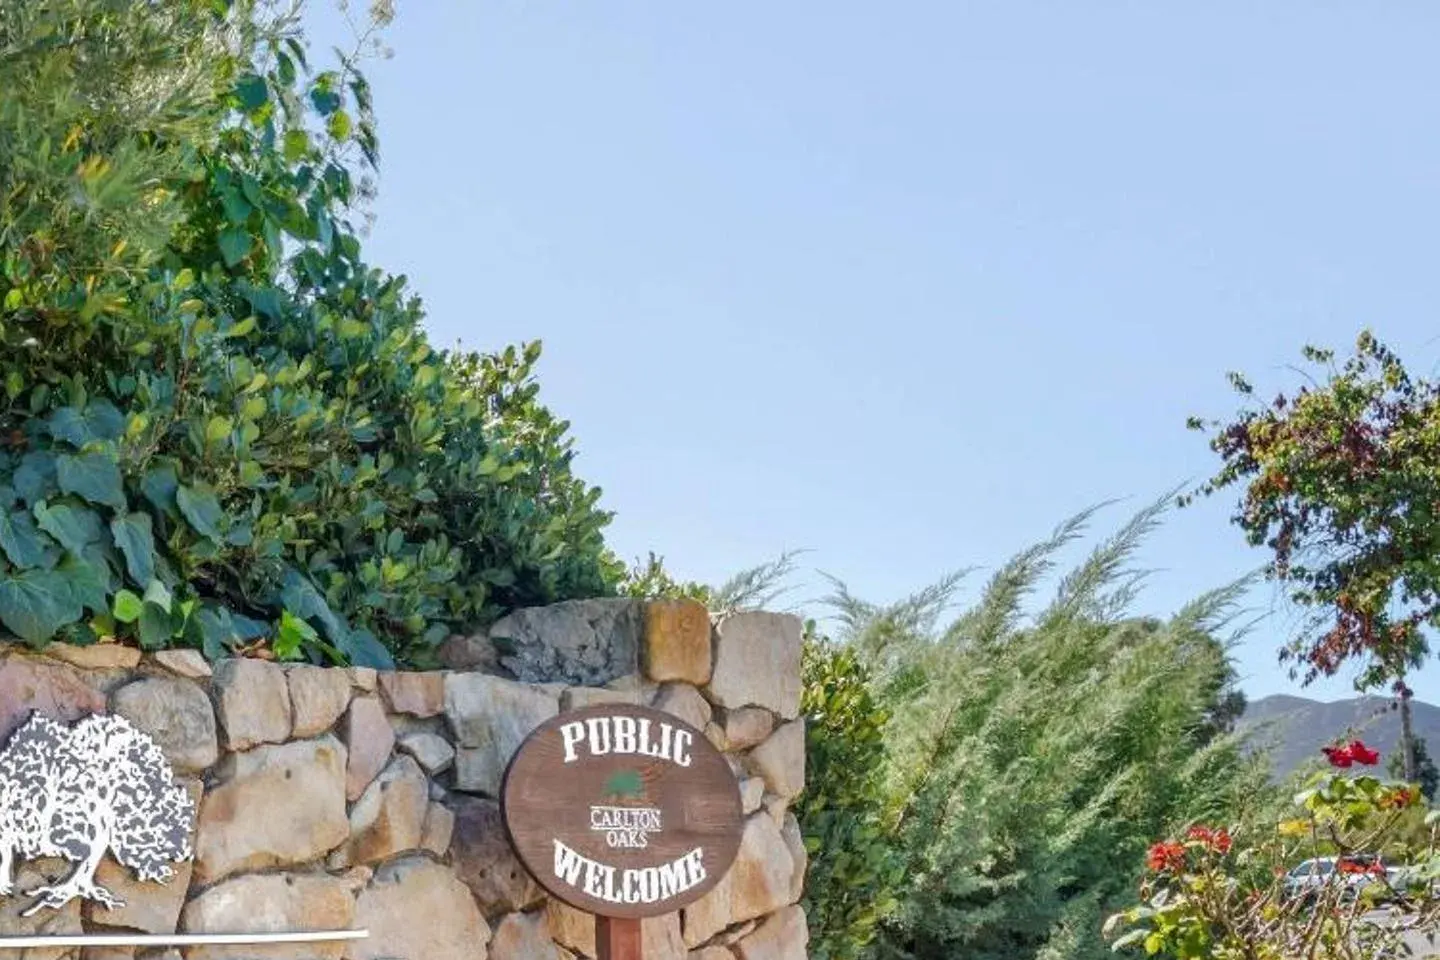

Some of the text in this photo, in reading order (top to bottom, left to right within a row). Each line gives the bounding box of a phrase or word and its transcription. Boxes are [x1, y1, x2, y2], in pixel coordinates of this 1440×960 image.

[560, 716, 692, 767] PUBLIC
[590, 808, 662, 830] CARLTON
[606, 830, 648, 848] OAKS
[552, 838, 707, 904] WELCOME
